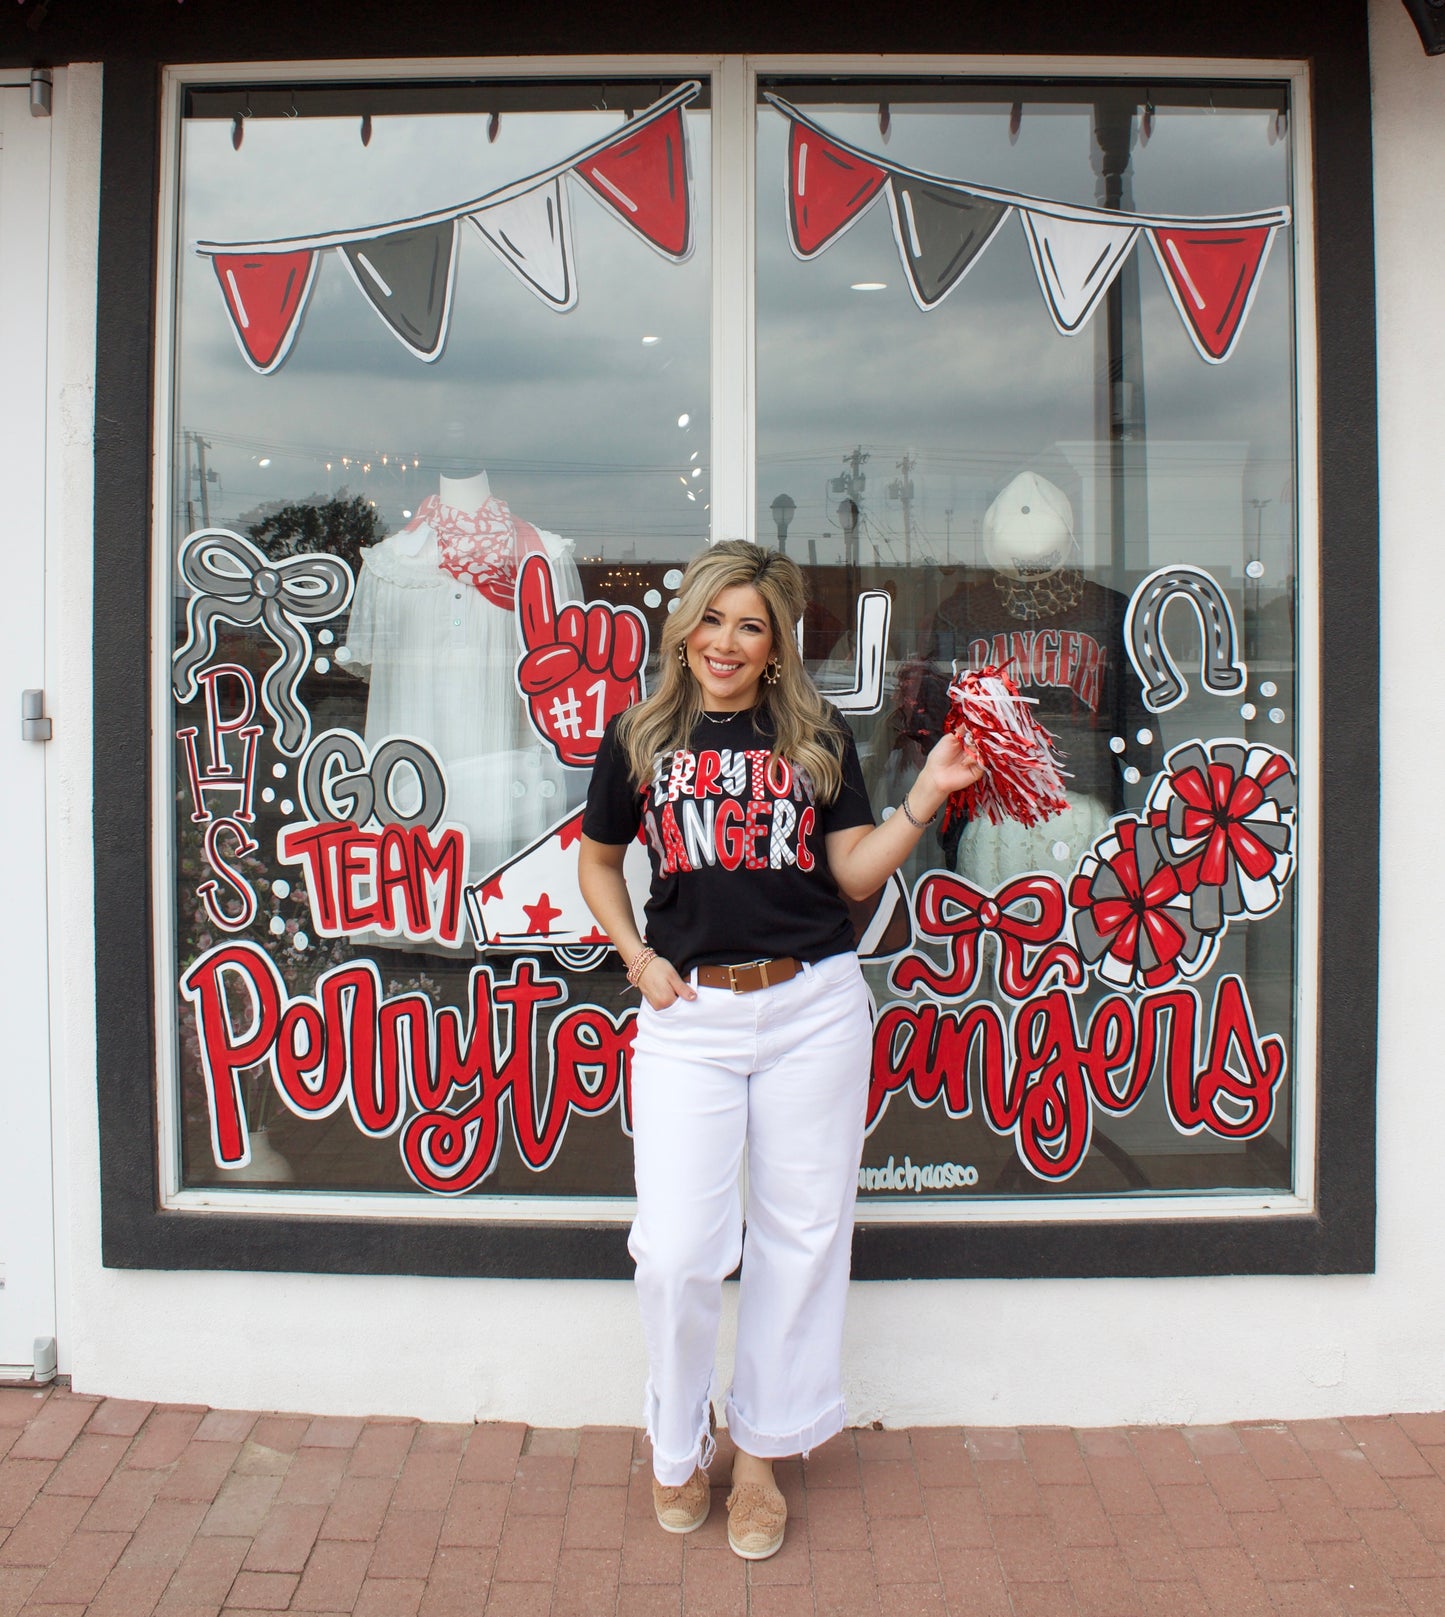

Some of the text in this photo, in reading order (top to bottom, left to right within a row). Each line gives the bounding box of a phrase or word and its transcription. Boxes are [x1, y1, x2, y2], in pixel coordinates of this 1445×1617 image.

[549, 679, 607, 739] #1
[300, 730, 447, 833] GO
[279, 820, 468, 946] TEAM
[863, 974, 1284, 1181] angers
